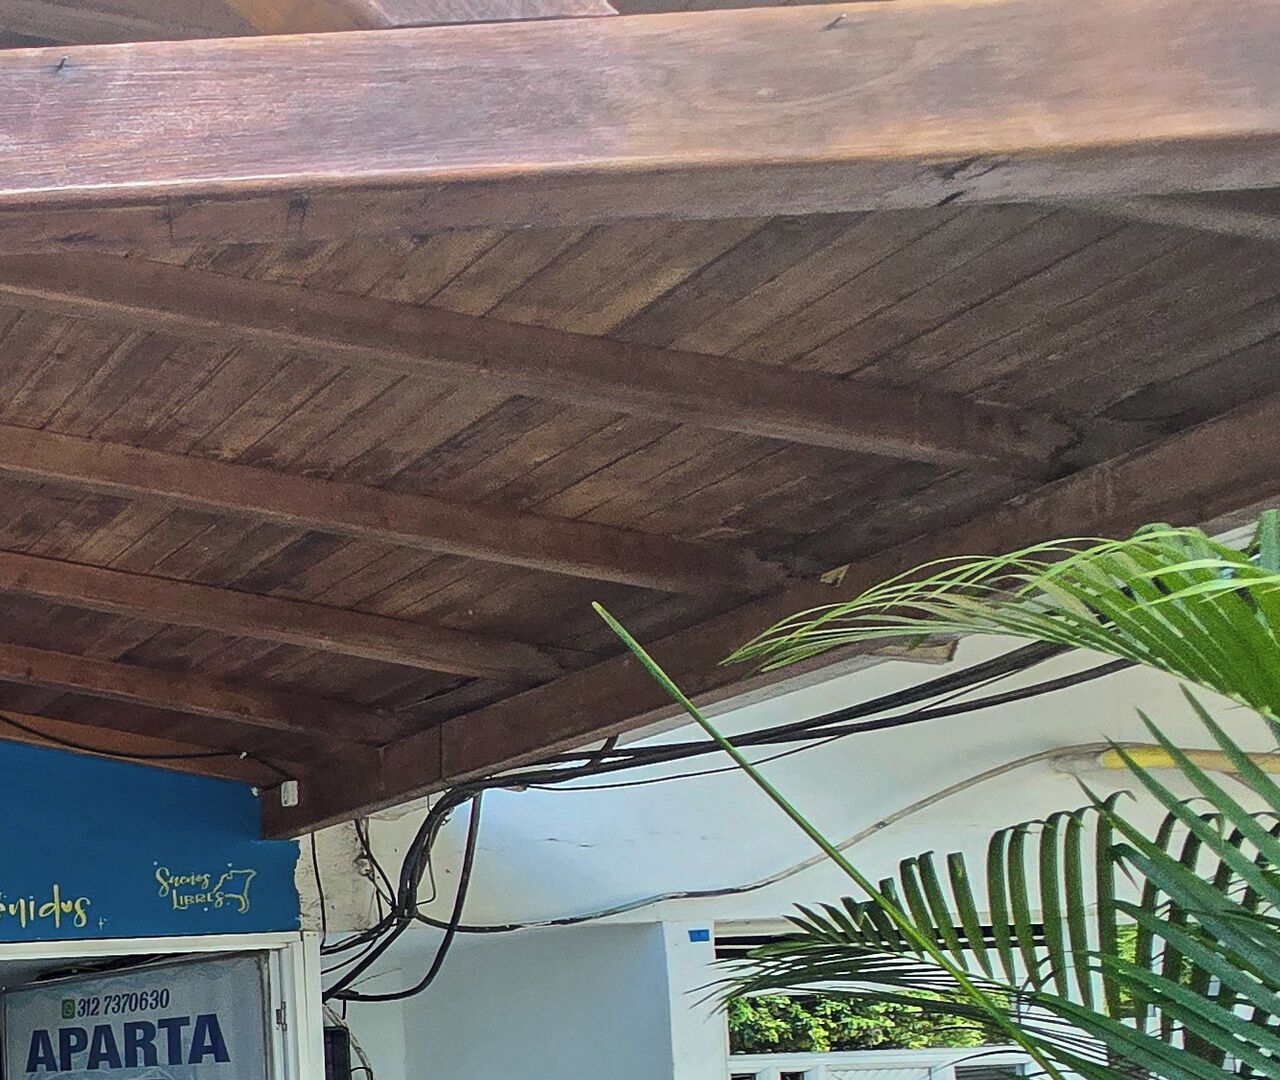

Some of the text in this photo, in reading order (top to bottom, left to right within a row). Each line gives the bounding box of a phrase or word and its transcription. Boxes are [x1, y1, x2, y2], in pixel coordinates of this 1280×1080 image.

[77, 988, 170, 1018] 312 7370630
[25, 1013, 231, 1073] APARTA
